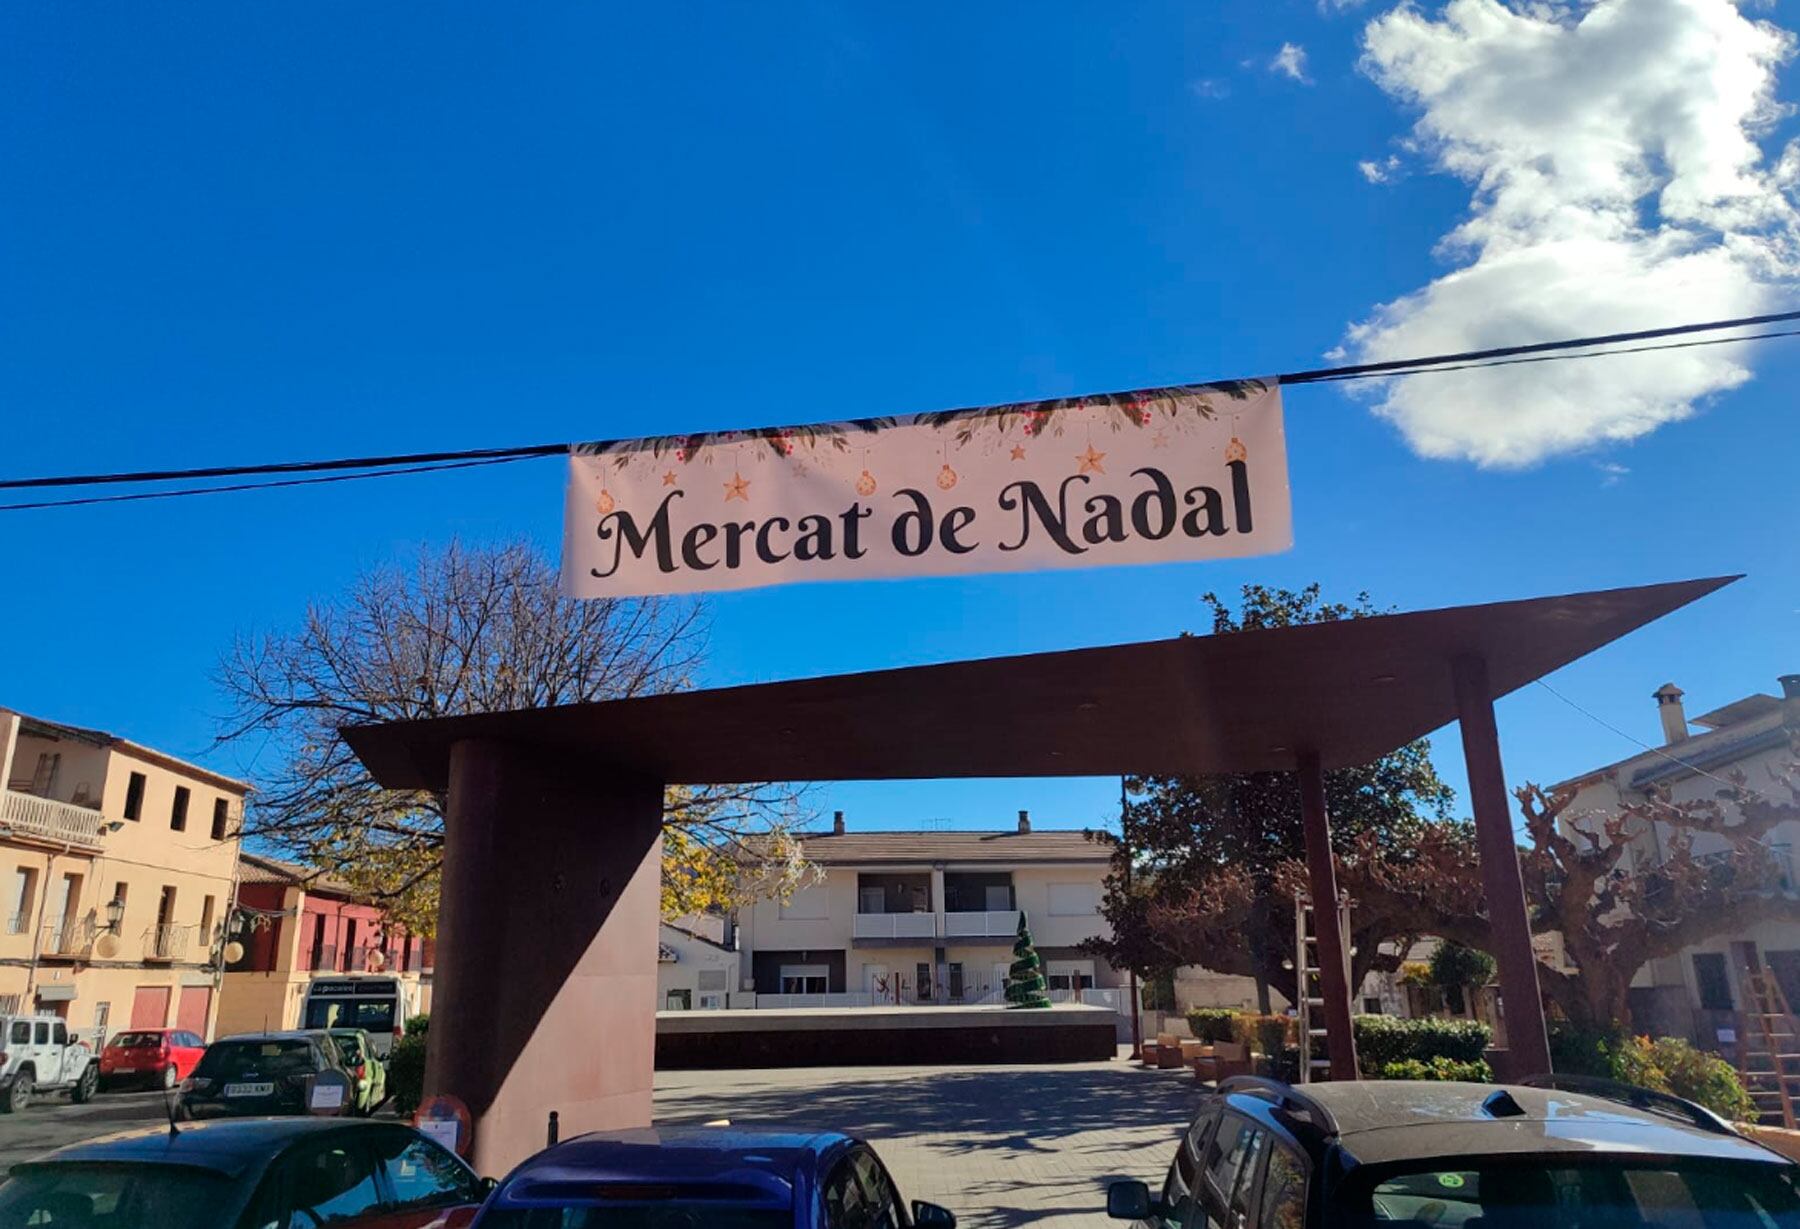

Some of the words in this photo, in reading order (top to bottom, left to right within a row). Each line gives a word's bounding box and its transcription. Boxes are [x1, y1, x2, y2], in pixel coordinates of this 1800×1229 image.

[590, 488, 873, 579] Mercat
[891, 487, 980, 557] de
[998, 459, 1254, 555] Nadal
